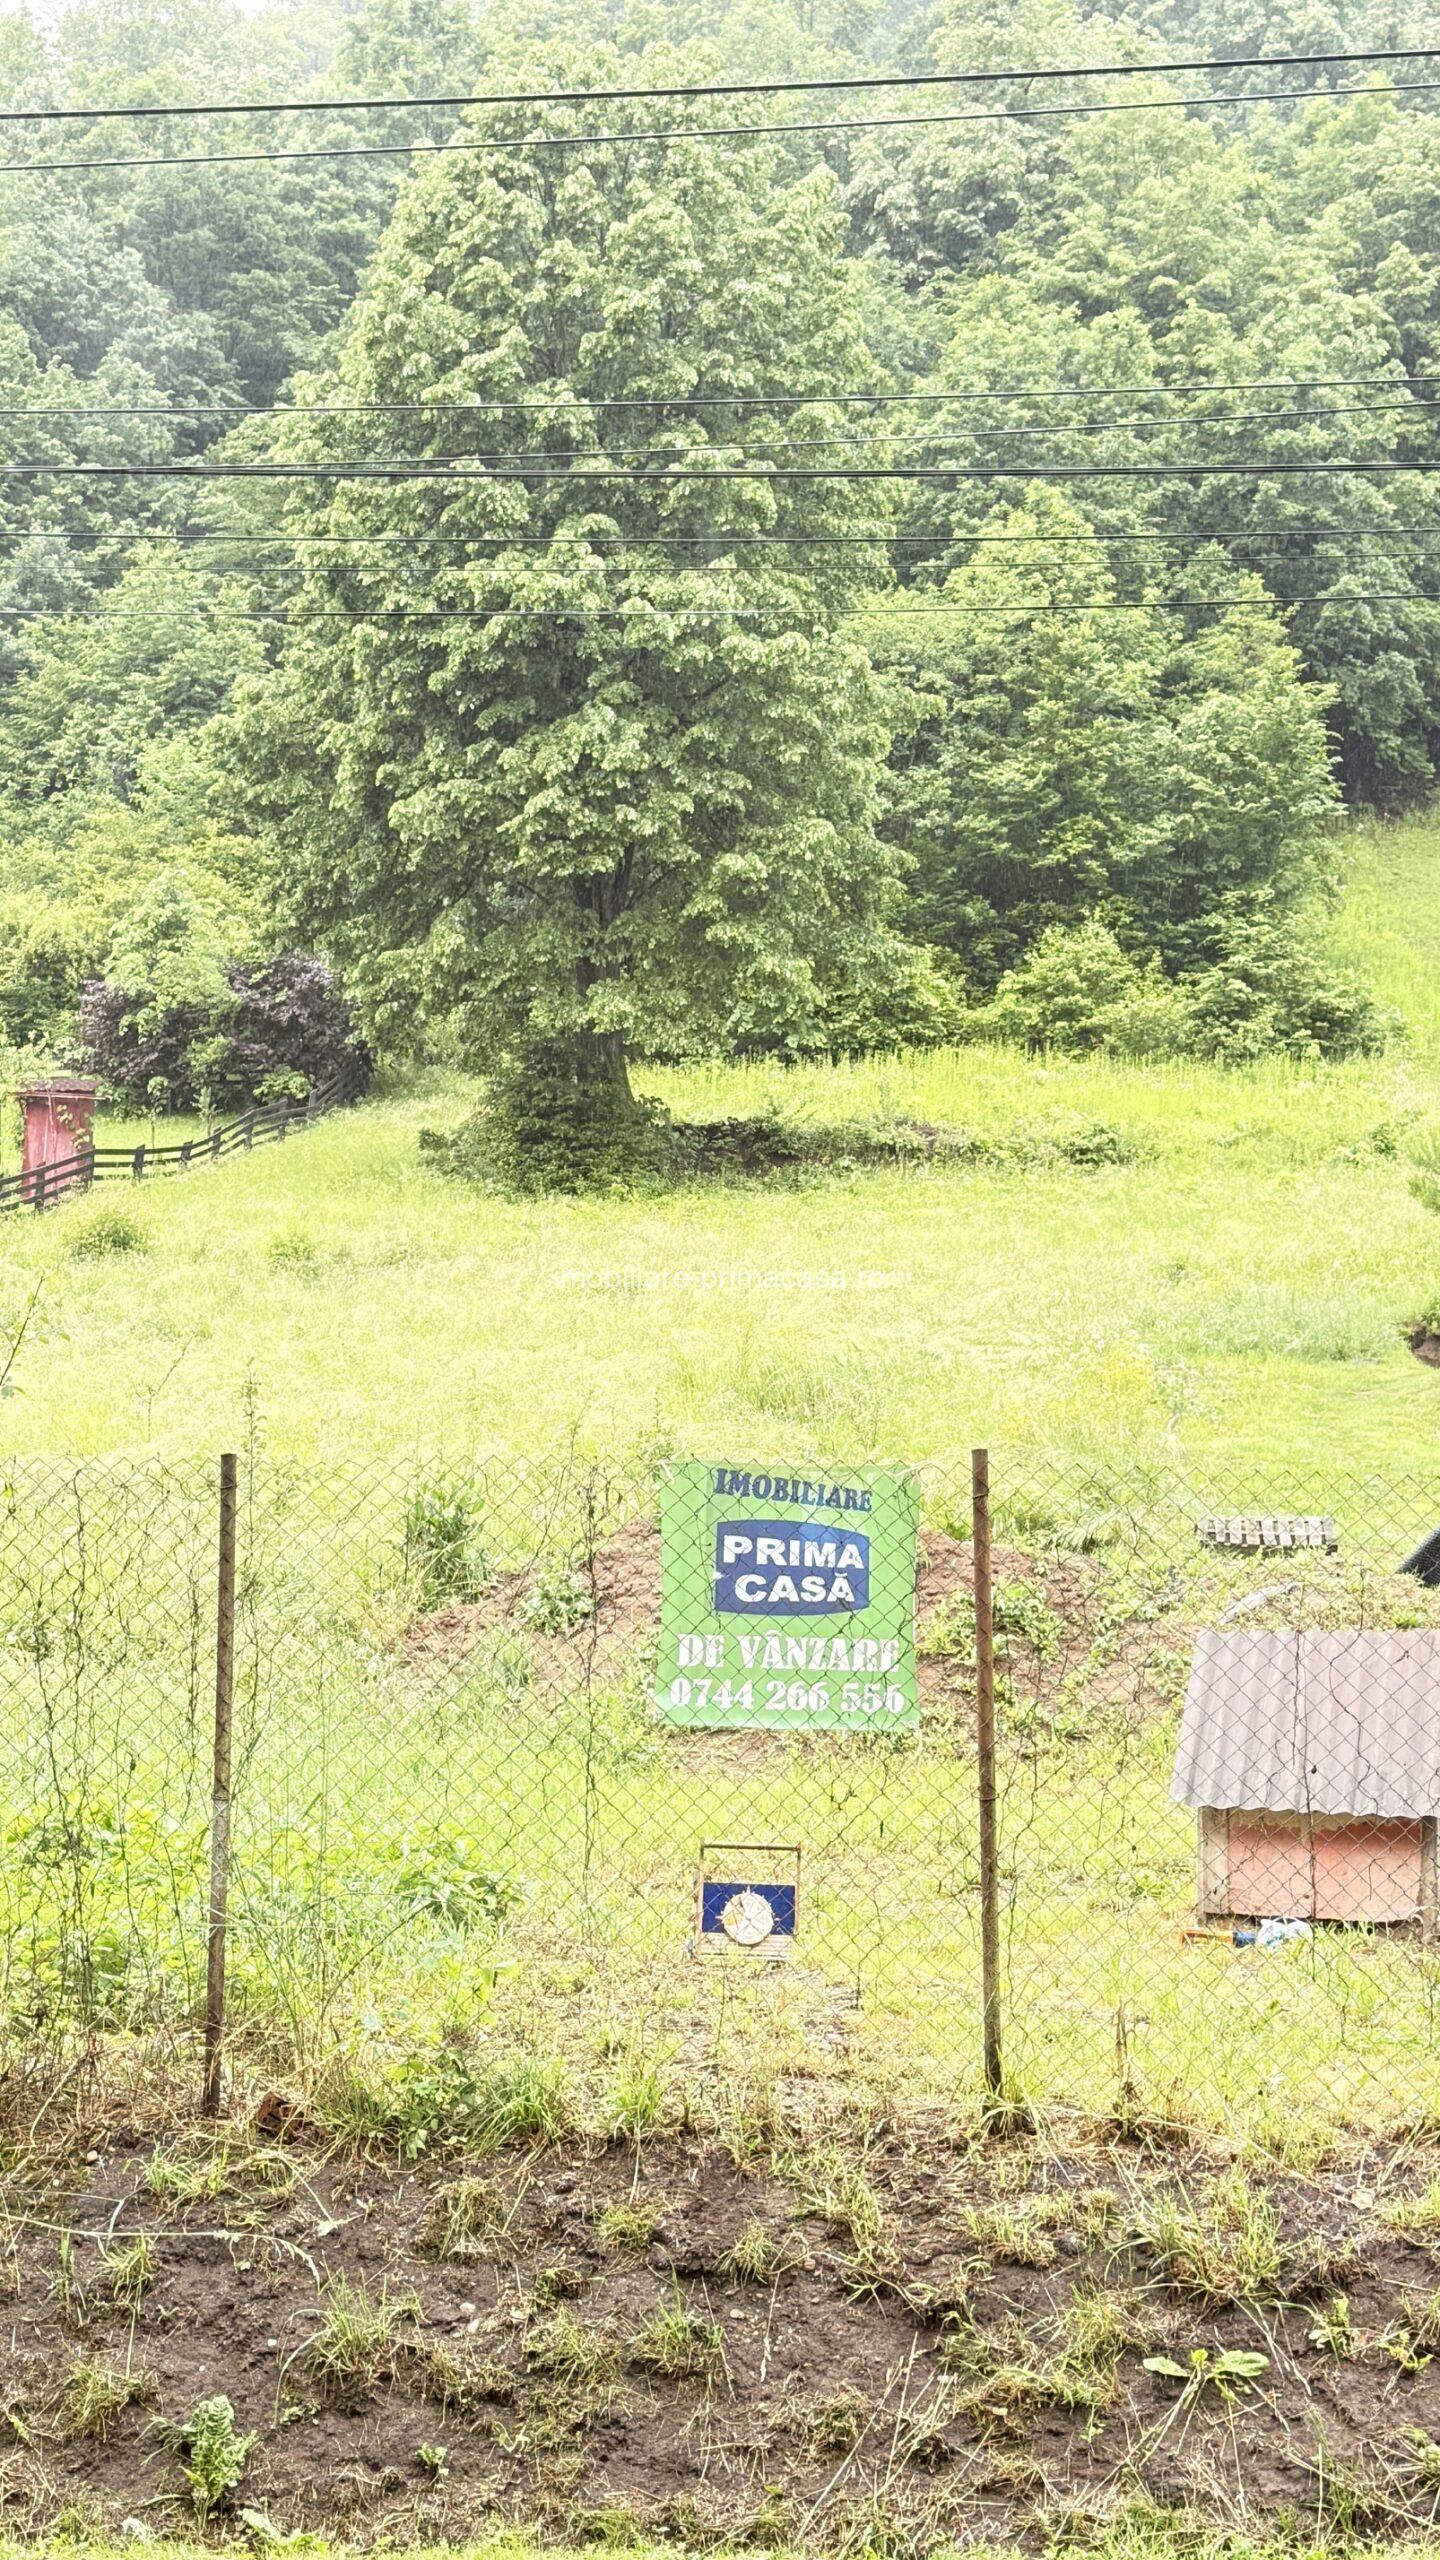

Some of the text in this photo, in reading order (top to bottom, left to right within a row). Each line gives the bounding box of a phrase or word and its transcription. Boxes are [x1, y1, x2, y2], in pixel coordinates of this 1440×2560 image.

[714, 1468, 873, 1512] IMOBILIARE
[723, 1535, 864, 1569] PRIMA
[734, 1572, 855, 1602] CASĂ
[677, 1630, 901, 1673] DE VÂNZARE
[669, 1677, 905, 1714] 0744 266 556
